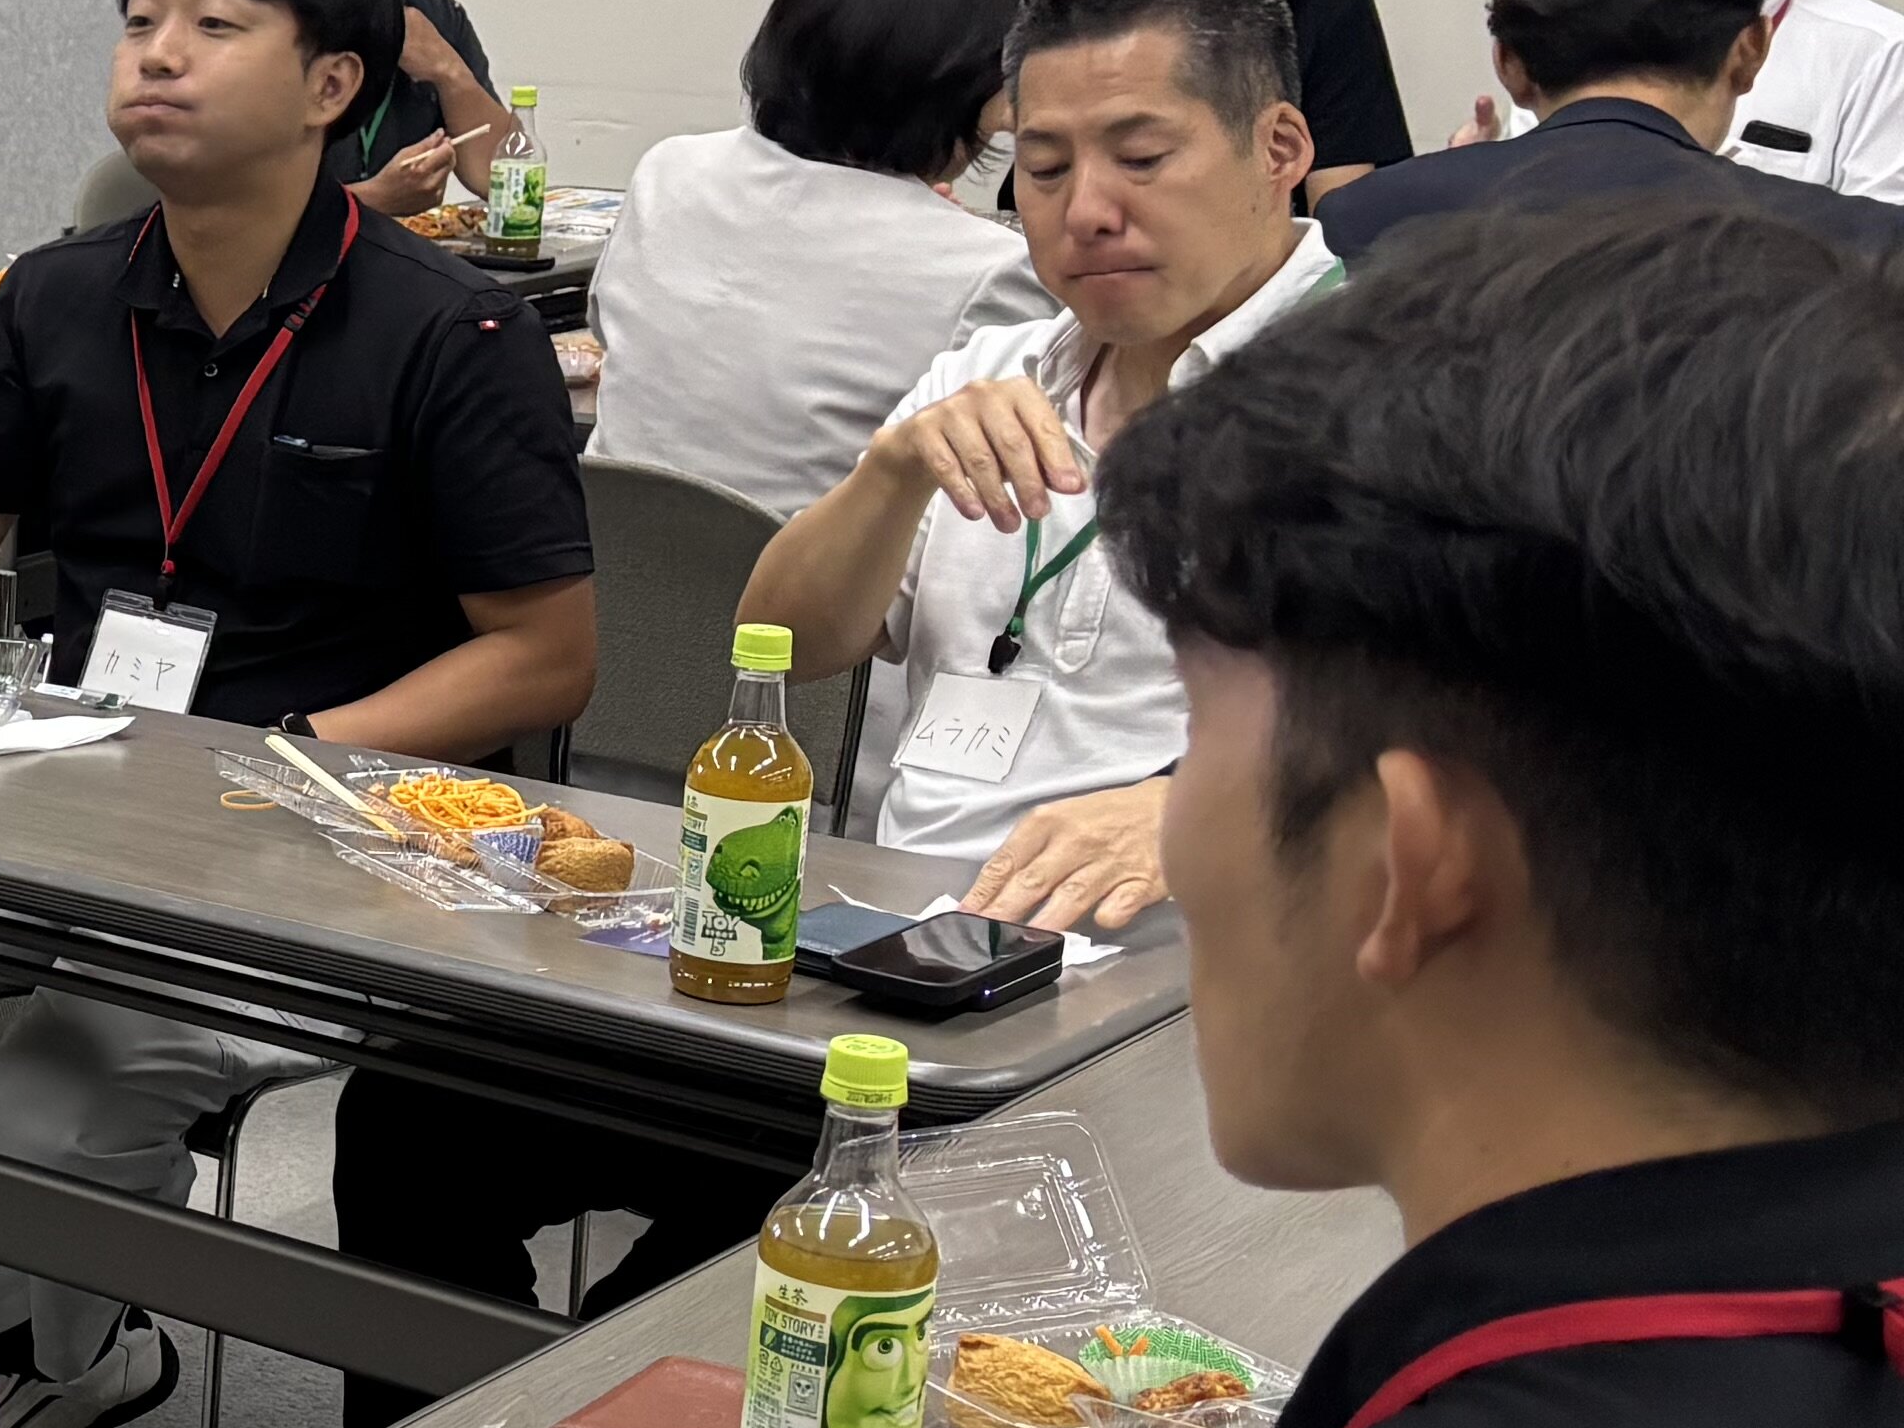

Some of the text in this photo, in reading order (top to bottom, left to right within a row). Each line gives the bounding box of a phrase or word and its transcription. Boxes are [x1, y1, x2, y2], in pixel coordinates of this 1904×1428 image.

[104, 649, 177, 691] カミヤ
[915, 718, 1011, 759] ムラカミ
[701, 910, 742, 931] TOY
[710, 938, 726, 956] 5
[778, 1283, 809, 1307] 生茶
[780, 1314, 817, 1338] STORY
